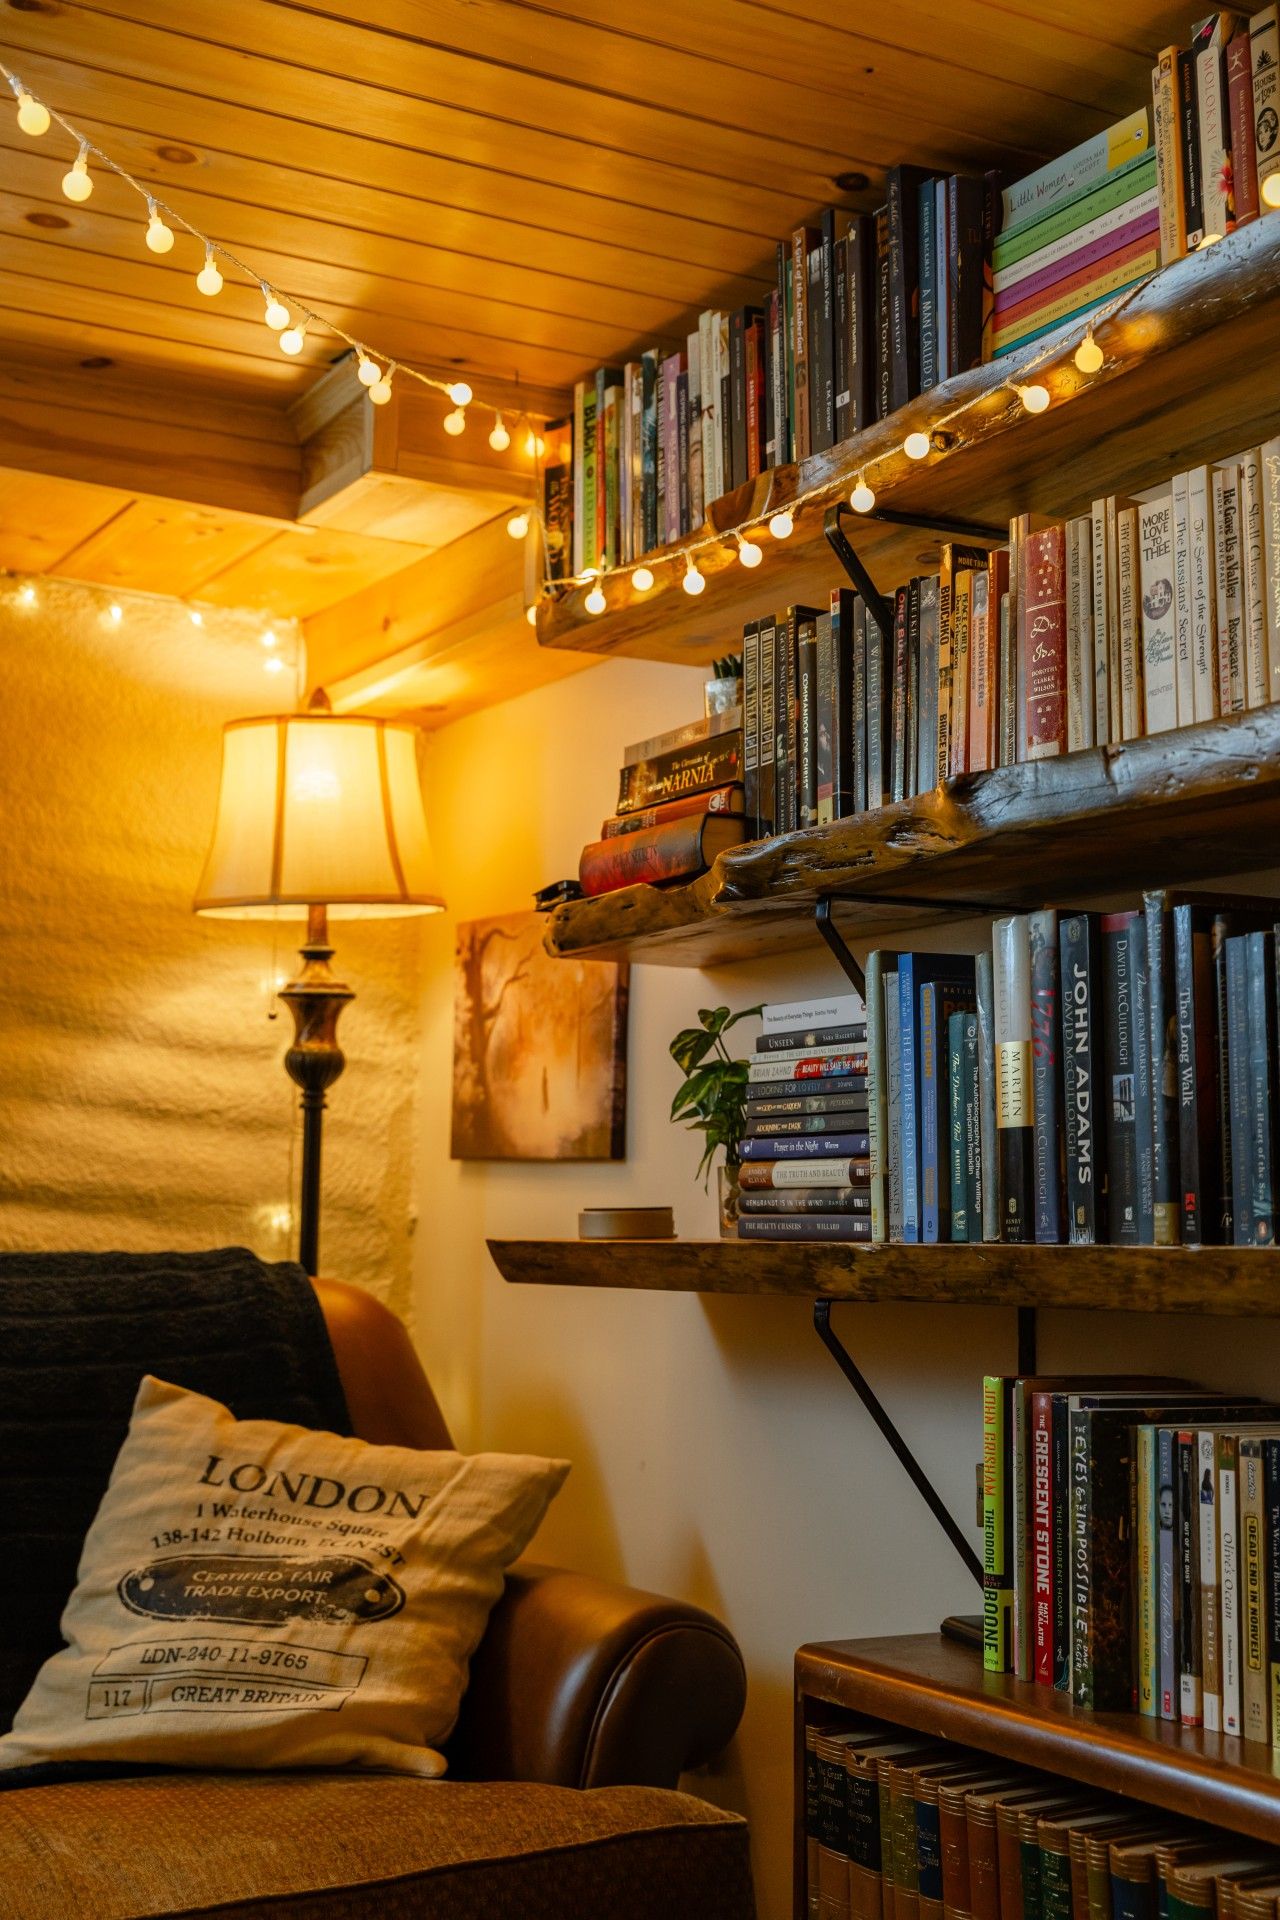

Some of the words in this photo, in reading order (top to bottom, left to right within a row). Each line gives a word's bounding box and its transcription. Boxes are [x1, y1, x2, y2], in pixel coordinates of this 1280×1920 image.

[1254, 72, 1277, 92] HOUSE
[1010, 193, 1034, 213] Little
[1036, 175, 1068, 199] Women
[923, 202, 932, 237] FREDRIK
[795, 248, 805, 269] Girl
[923, 240, 932, 280] BACKMAN
[796, 283, 805, 301] the
[880, 261, 889, 317] UNCLE
[922, 288, 932, 298] A
[796, 302, 805, 357] Limberlost
[922, 300, 933, 330] MAN
[881, 320, 889, 364] TOM'S
[923, 332, 934, 375] CALLED
[583, 404, 598, 459] BLACK
[1223, 487, 1236, 506] He
[1095, 518, 1104, 549] don't
[1120, 521, 1130, 542] THY
[1142, 508, 1171, 529] MORE
[1143, 520, 1169, 541] LOVE
[1176, 517, 1188, 545] The
[1193, 518, 1206, 544] The
[1224, 506, 1237, 536] Gave
[1142, 540, 1171, 562] THEE
[1151, 536, 1163, 546] TO
[1225, 539, 1238, 553] Us
[1121, 544, 1132, 581] PEOPLE
[1193, 545, 1205, 587] Secret
[1177, 549, 1190, 614] Russians'
[1195, 588, 1206, 601] of
[1225, 563, 1240, 601] Valley
[910, 589, 918, 637] SHEIKH
[961, 592, 969, 622] PEACE
[1096, 593, 1104, 618] your
[1122, 585, 1132, 621] SHALL
[1196, 602, 1207, 621] the
[961, 624, 969, 654] CHILD
[1030, 615, 1059, 639] Dr.
[1123, 620, 1132, 633] BE
[1179, 617, 1190, 662] Secret
[1032, 641, 1057, 663] Ida
[1123, 637, 1133, 654] MY
[1195, 623, 1208, 676] Strength
[1228, 617, 1241, 680] Roseveare
[746, 646, 757, 689] HUDSON
[978, 617, 986, 708] HEADHUNTERS
[1123, 656, 1134, 694] PEOPLE
[1033, 683, 1056, 693] WILSON
[746, 691, 758, 736] TAYLOR
[660, 762, 716, 796] NARNIA
[802, 757, 810, 790] CHRIST
[923, 988, 932, 1023] BORN
[1063, 990, 1075, 1041] DAVID
[1073, 963, 1089, 1054] JOHN
[1179, 987, 1192, 1020] The
[903, 1026, 913, 1051] THE
[924, 1028, 932, 1044] TO
[1031, 988, 1057, 1068] 1776
[1137, 1011, 1145, 1037] FROM
[768, 1037, 795, 1049] UNSEEN
[822, 1034, 835, 1042] SARA
[1179, 1024, 1193, 1063] Long
[752, 1066, 771, 1079] BRIAN
[772, 1064, 793, 1077] ZAHND
[802, 1062, 819, 1075] BEAUTY
[924, 1046, 933, 1078] RUN
[1139, 1039, 1147, 1097] DARKNESS
[1000, 1048, 1010, 1121] GILBERT
[1011, 1050, 1022, 1118] MARTIN
[1036, 1066, 1048, 1108] DAVID
[1182, 1066, 1194, 1107] Walk
[761, 1104, 774, 1113] GOD
[783, 1102, 802, 1113] GARDEN
[830, 1098, 855, 1106] PETERSON
[904, 1061, 914, 1155] DEPRESSION
[966, 1102, 974, 1142] Benjamin
[972, 1083, 981, 1146] Autobiography
[1076, 1066, 1092, 1185] ADAMS
[776, 1170, 789, 1179] THE
[789, 1169, 807, 1179] TRUTH
[807, 1169, 822, 1178] AND
[822, 1168, 846, 1178] BEAUTY
[967, 1143, 975, 1175] Franklin
[906, 1163, 916, 1207] CURE
[974, 1180, 982, 1213] Writings
[745, 1221, 756, 1231] THE
[756, 1221, 777, 1231] BEAUTY
[777, 1221, 803, 1231] CHASERS
[816, 1222, 841, 1231] WILLARD
[984, 1386, 997, 1425] JOHN
[1074, 1424, 1087, 1433] THE
[984, 1431, 997, 1497] GRISHAM
[1074, 1435, 1088, 1484] EYES
[197, 1455, 429, 1520] LONDON
[1035, 1429, 1050, 1528] CRESCENT
[1074, 1485, 1087, 1502] &
[1246, 1460, 1257, 1500] Gantos
[212, 1502, 322, 1530] Waterhouse
[326, 1519, 390, 1541] Square
[1075, 1503, 1087, 1513] THE
[153, 1528, 222, 1550] 138-142
[985, 1508, 995, 1573] THEODORE
[1248, 1524, 1259, 1556] DEAD
[192, 1570, 284, 1584] CERTIFIED
[289, 1570, 333, 1584] FAIR
[1036, 1529, 1050, 1595] STONE
[1074, 1513, 1088, 1635] IMPOSSIBLE
[1248, 1561, 1259, 1585] END
[183, 1585, 242, 1598] TRADE
[1249, 1588, 1259, 1601] IN
[984, 1590, 999, 1653] BOONE
[1037, 1601, 1045, 1647] MIKALATOS
[1249, 1606, 1260, 1661] NORVELT
[139, 1646, 309, 1671] LDN-240-11-9765
[1074, 1638, 1083, 1674] EGGERS
[103, 1689, 131, 1709] 117
[170, 1686, 237, 1704] GREAT
[241, 1689, 327, 1705] BRITAIN
